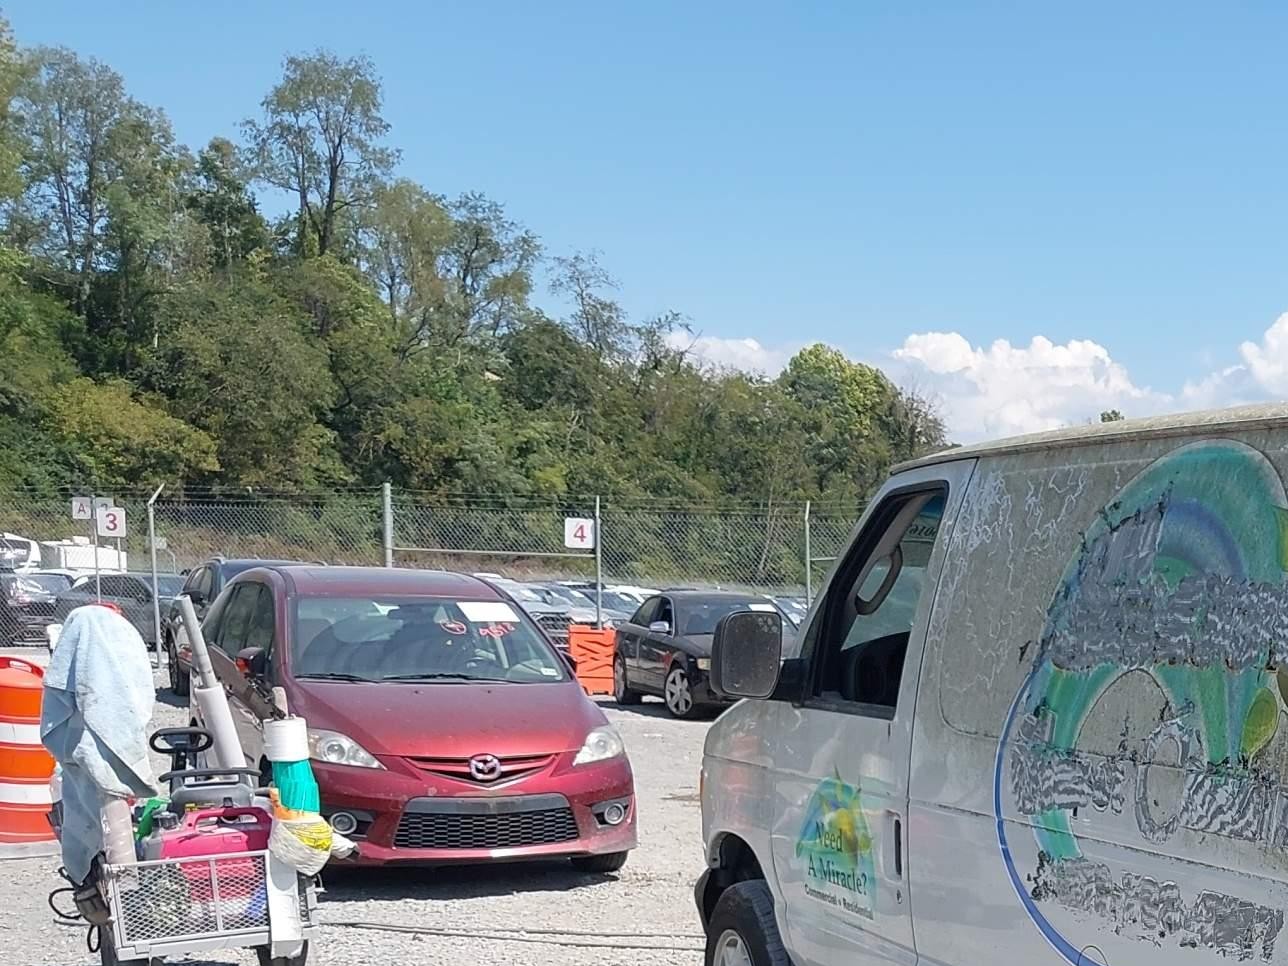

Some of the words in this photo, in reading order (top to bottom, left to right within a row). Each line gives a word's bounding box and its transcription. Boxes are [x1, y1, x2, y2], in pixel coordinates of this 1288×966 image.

[78, 503, 86, 514] A
[105, 513, 117, 531] 3
[573, 524, 587, 543] 4
[816, 822, 842, 852] Need
[808, 855, 817, 878] A
[820, 859, 867, 896] Miracle?
